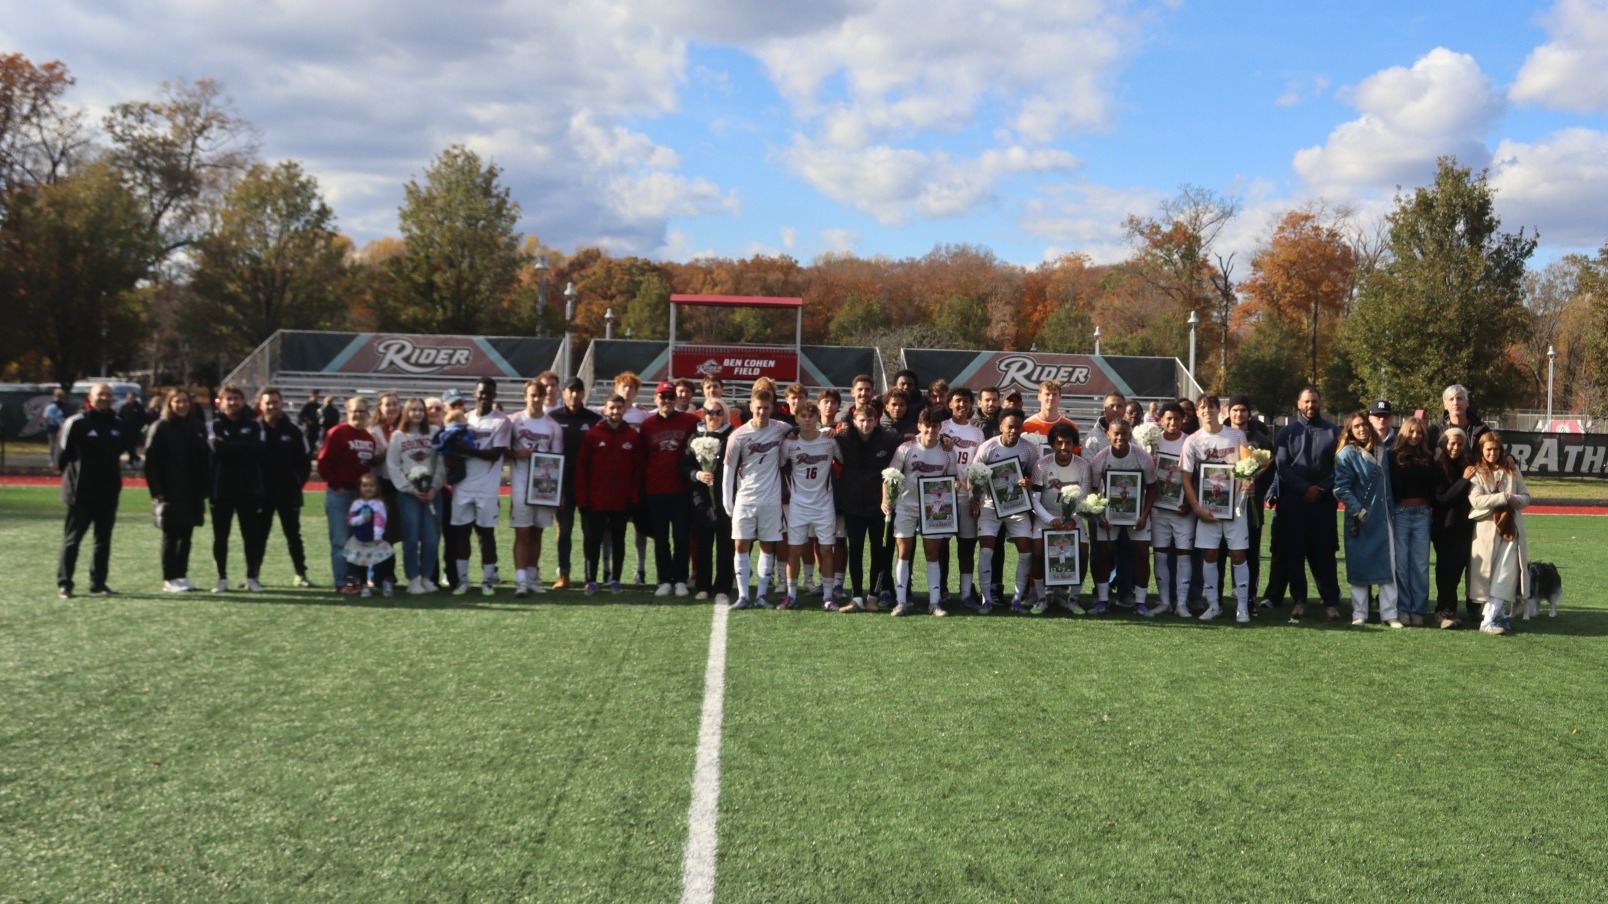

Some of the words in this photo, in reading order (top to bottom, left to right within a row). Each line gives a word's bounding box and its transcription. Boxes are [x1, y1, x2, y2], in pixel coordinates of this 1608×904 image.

[376, 338, 471, 374] RIDER
[723, 358, 742, 367] BEN
[744, 359, 775, 368] COHEN
[733, 367, 760, 376] FIELD
[998, 356, 1089, 391] RIDER
[957, 451, 969, 465] 19
[805, 467, 818, 480] 16
